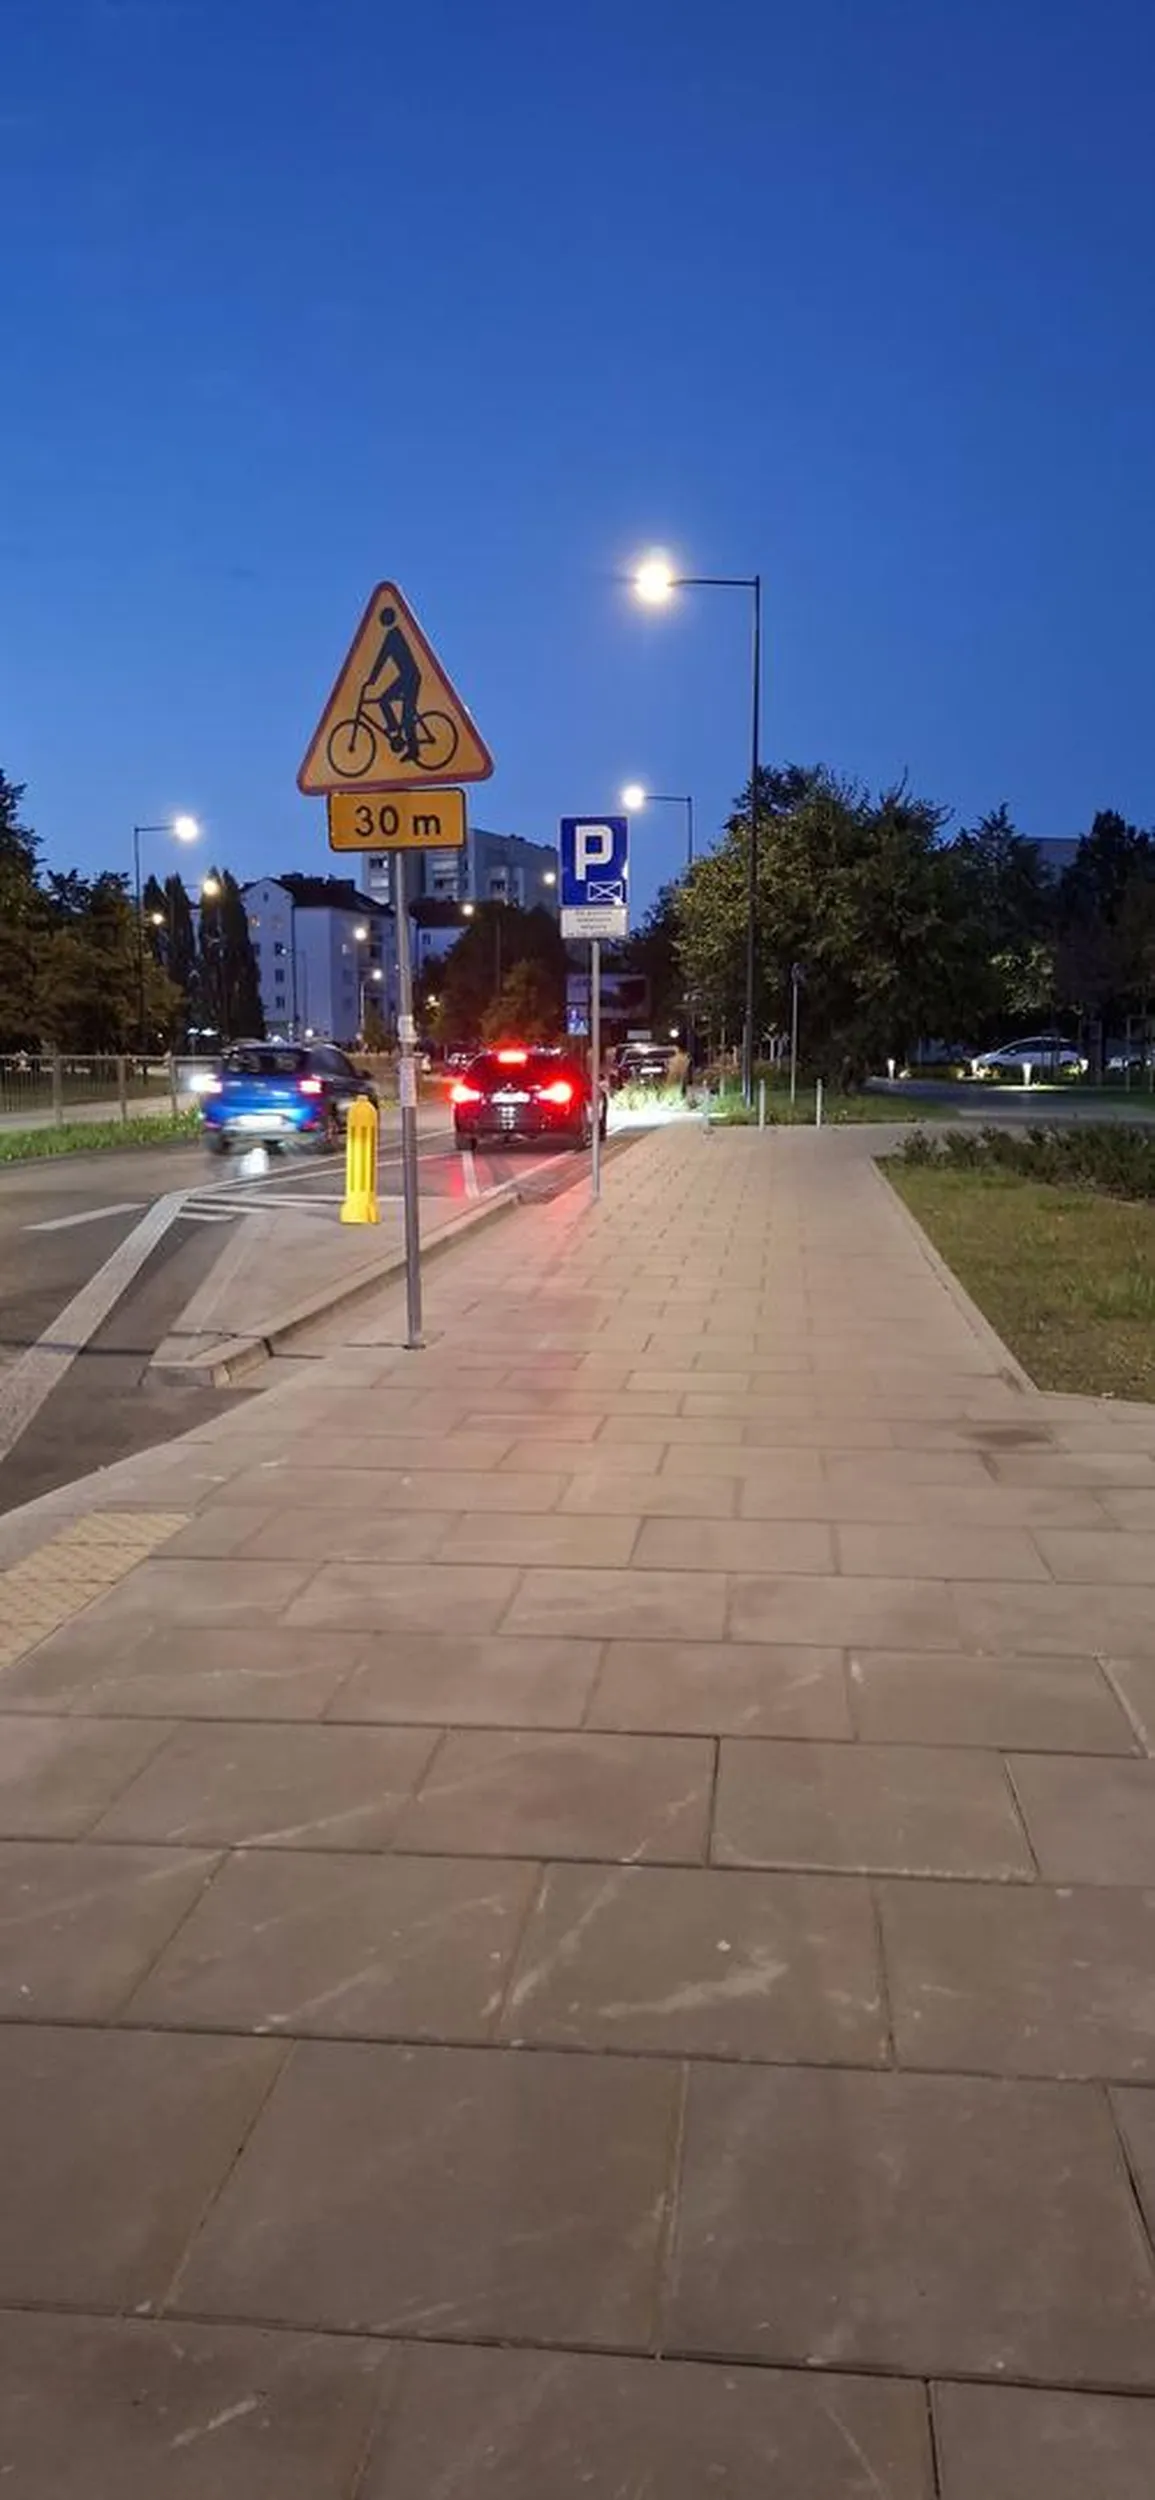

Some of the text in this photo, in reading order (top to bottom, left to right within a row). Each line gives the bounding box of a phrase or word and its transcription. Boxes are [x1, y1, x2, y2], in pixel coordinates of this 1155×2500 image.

[355, 805, 441, 837] 30 m
[575, 825, 613, 880] P
